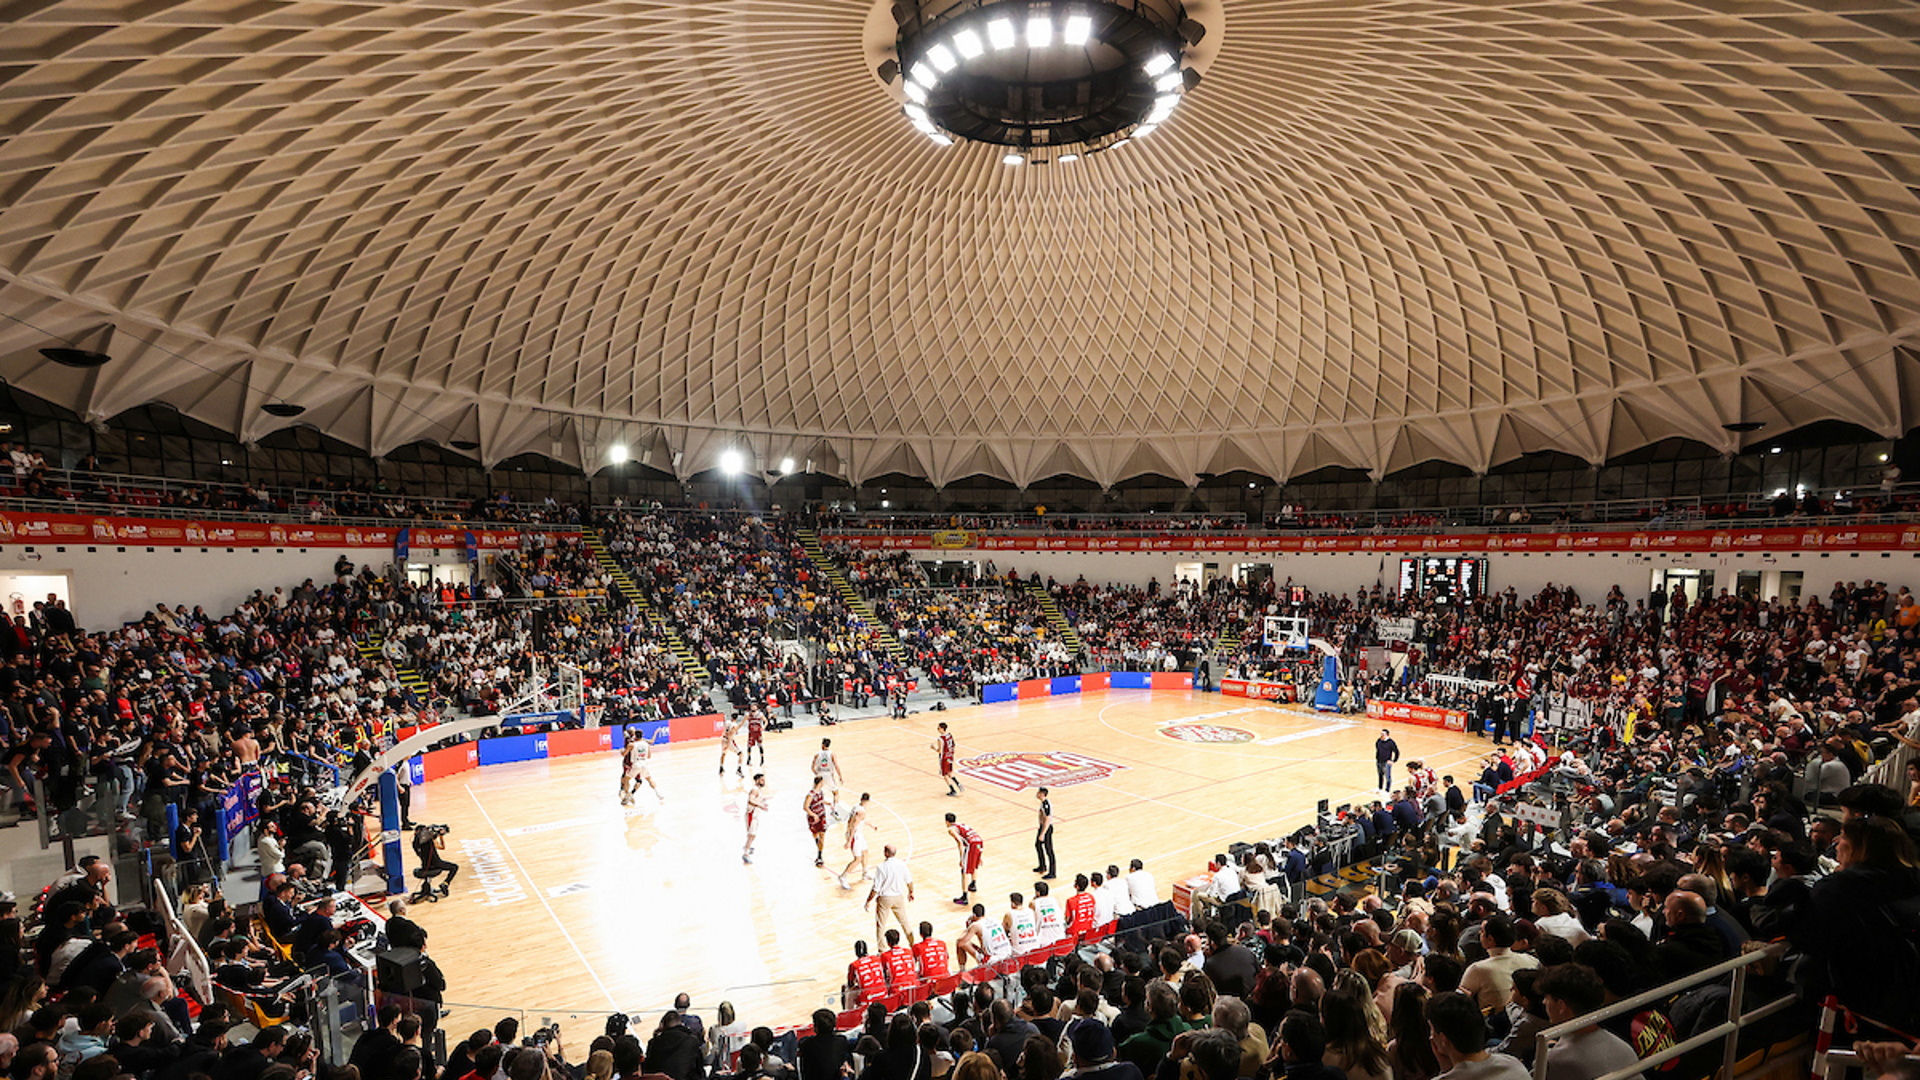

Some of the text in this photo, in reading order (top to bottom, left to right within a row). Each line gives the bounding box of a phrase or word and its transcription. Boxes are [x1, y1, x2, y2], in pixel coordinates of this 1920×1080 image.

[961, 752, 1127, 791] ITALIA
[456, 838, 528, 906] ticketmaster
[1637, 1009, 1667, 1058] SANTA
